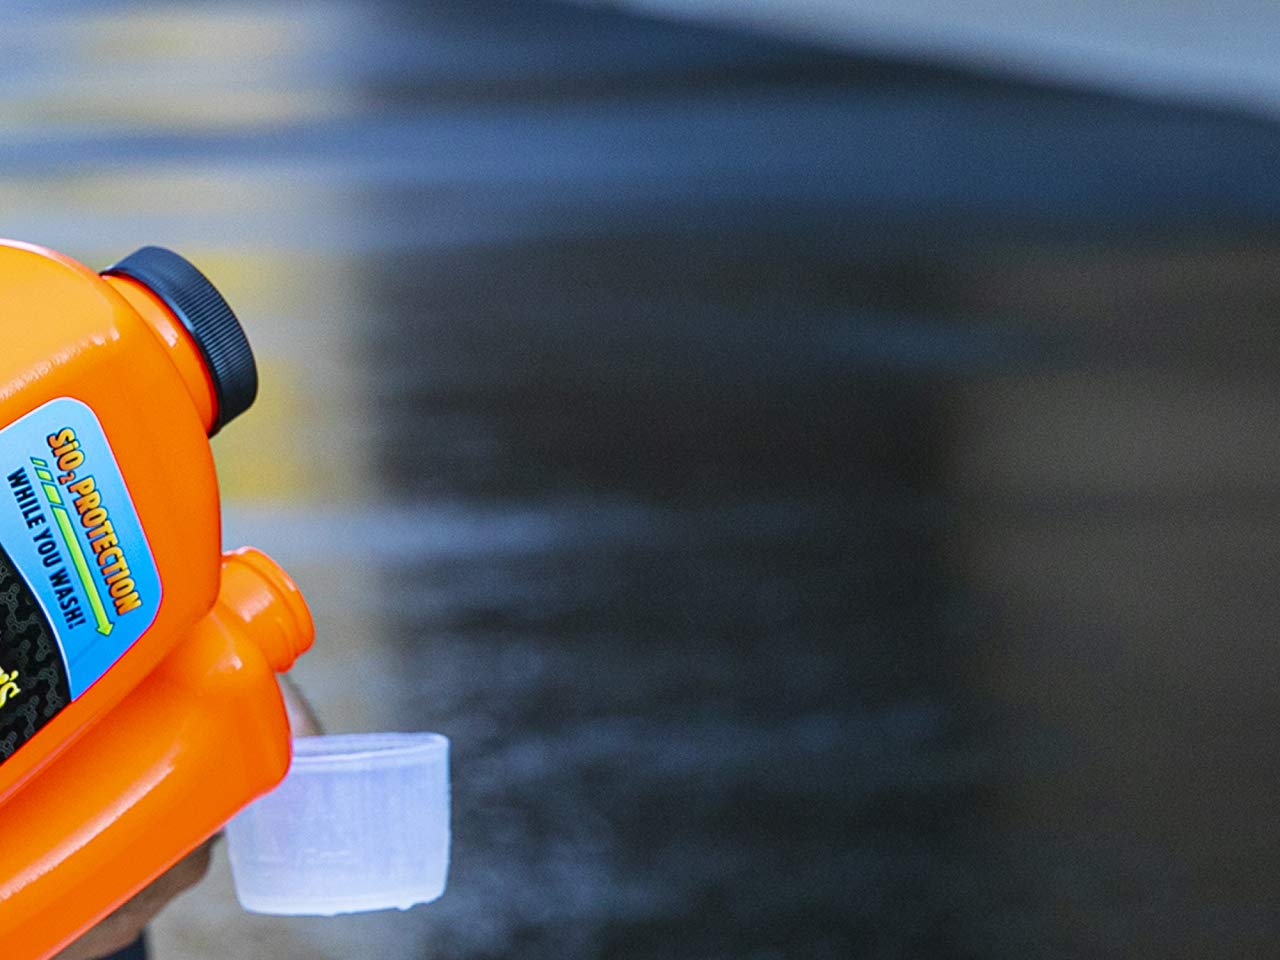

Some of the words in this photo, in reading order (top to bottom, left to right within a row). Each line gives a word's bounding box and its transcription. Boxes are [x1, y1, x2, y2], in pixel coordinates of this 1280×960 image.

[7, 467, 46, 529] WHILE
[33, 528, 62, 568] YOU
[50, 568, 86, 629] WASH!
[68, 475, 142, 616] PROTECTION
